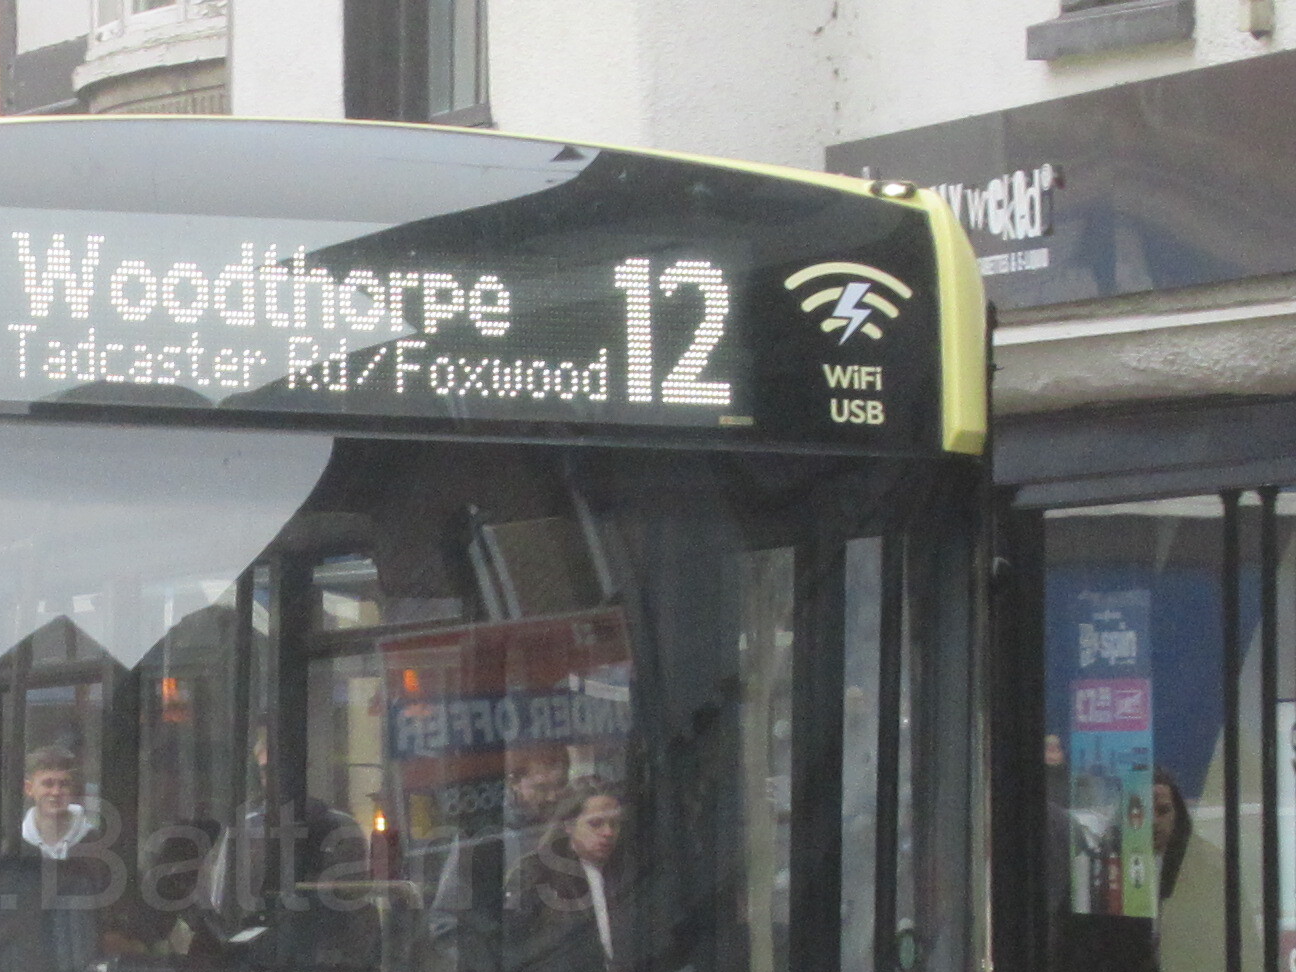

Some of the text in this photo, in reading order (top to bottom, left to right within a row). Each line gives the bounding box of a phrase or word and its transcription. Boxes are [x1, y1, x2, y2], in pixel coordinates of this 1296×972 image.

[12, 230, 511, 336] Woodthorpe
[7, 323, 267, 387] Tadcaster
[289, 336, 608, 400] Rd/Foxwood
[614, 257, 731, 405] 12
[822, 363, 883, 391] WiFi
[830, 398, 885, 425] USB
